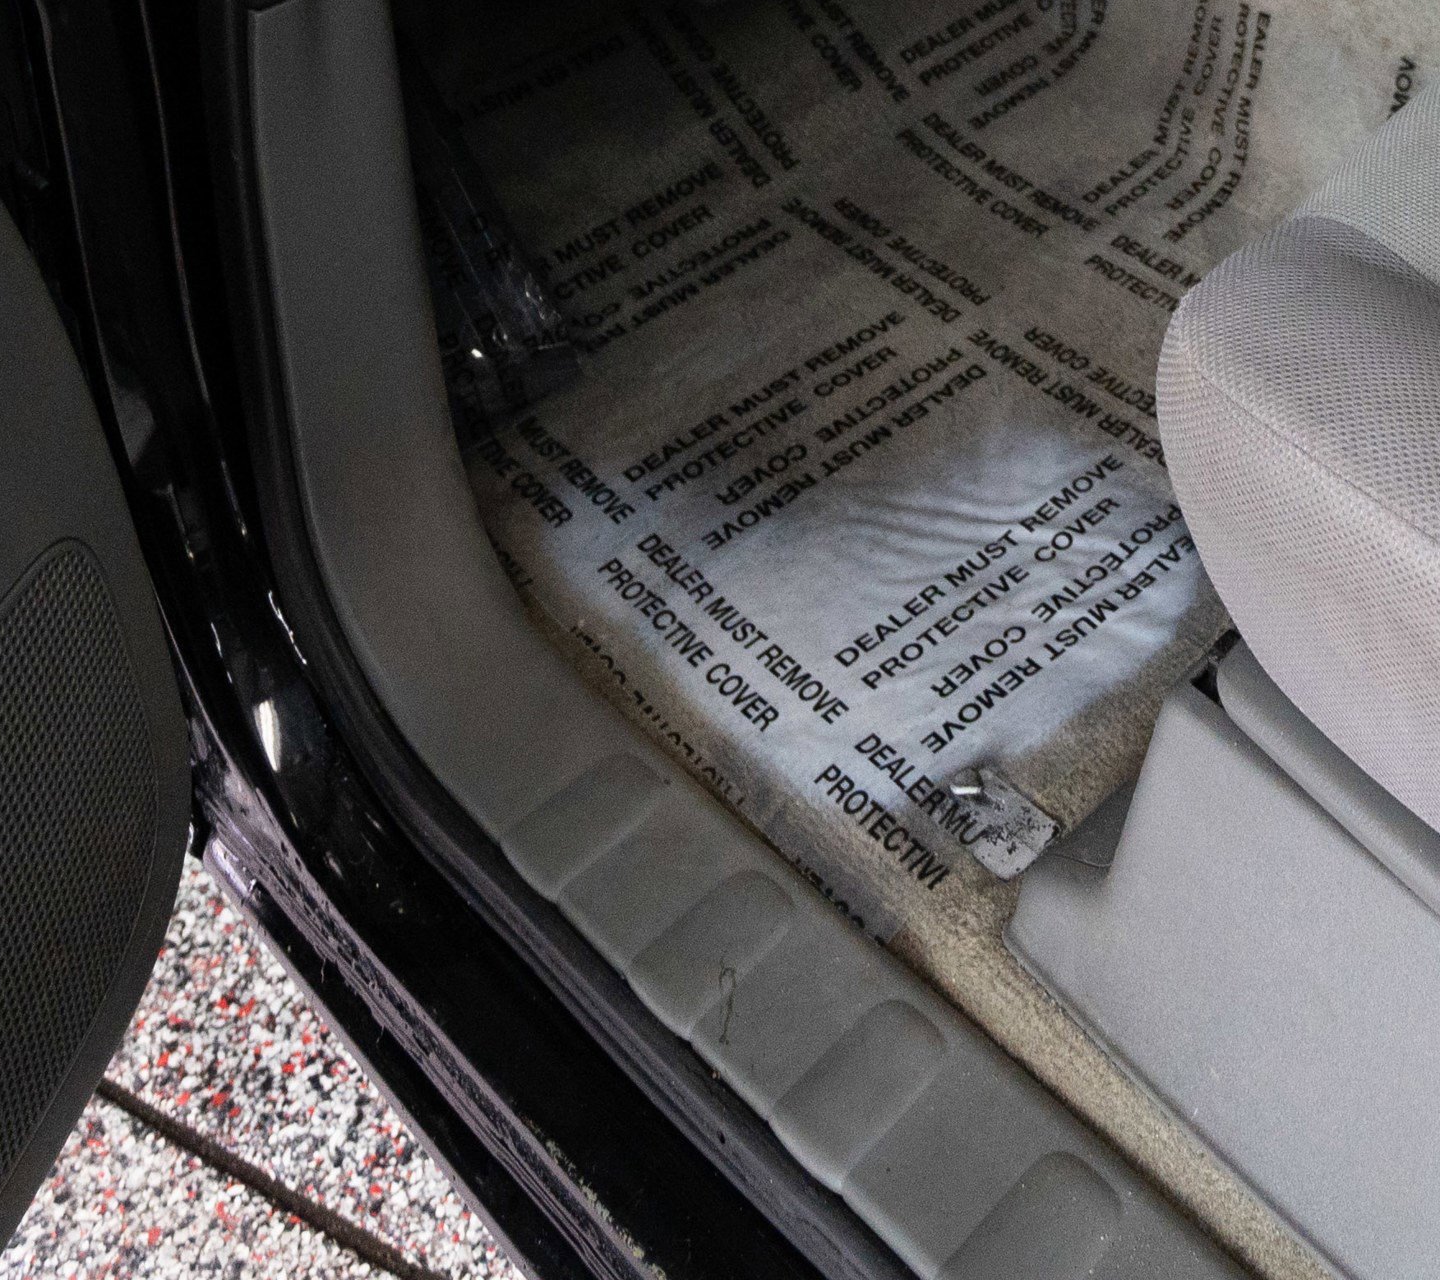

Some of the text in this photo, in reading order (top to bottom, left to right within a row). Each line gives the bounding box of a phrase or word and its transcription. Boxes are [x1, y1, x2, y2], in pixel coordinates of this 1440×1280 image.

[811, 33, 862, 92] COVER
[850, 30, 910, 104] REMOVE
[900, 17, 974, 65] DEALER
[919, 12, 1035, 87] PROTECTIVE
[974, 55, 1039, 98] COVER
[1052, 31, 1098, 81] MUST
[1210, 2, 1251, 135] ROTECTIVE
[1246, 10, 1271, 91] EALER
[709, 117, 771, 189] DEALER
[711, 62, 800, 172] PROTECTIVE
[969, 77, 1051, 131] REMOVE
[1082, 149, 1158, 205] DEALER
[1154, 83, 1186, 147] MUST
[1105, 16, 1223, 216] PROTECTIVE COVER
[1233, 96, 1251, 165] MUST
[554, 160, 724, 264] MUST REMOVE
[896, 128, 1049, 238] PROTECTIVE COVER
[923, 112, 1101, 232] DEALER MUST REMOVE
[1163, 171, 1241, 243] REMOVE
[1166, 146, 1222, 210] COVER
[553, 204, 714, 300] CTIVE COVER
[627, 216, 772, 300] PROTECTIVE
[630, 229, 792, 330] DEALER MUST
[781, 197, 963, 323] DEALER MUST REMOVE
[833, 196, 991, 307] PROTECTIVE COVER
[1111, 234, 1183, 283] DEALER
[623, 310, 906, 484] DEALER MUST REMOVE
[645, 345, 899, 502] PROTECTIVE COVER
[965, 328, 1102, 420] MUST REMOVE
[1024, 327, 1157, 420] TECTIVE COVER
[516, 416, 637, 525] MUST REMOVE
[700, 363, 988, 550] DEALER MUST REMOVE
[716, 347, 964, 507] PROTECTIVE COVER
[511, 469, 574, 530] COVER
[834, 454, 1125, 668] DEALER MUST REMOVE
[861, 497, 1121, 691] PROTECTIVE COVER
[930, 502, 1185, 699] PROTECTIVE COVER
[597, 558, 714, 670] PROTECTIVE
[705, 662, 779, 733] COVER
[637, 532, 715, 605] DEALER
[704, 596, 770, 651] MUST
[756, 643, 849, 727] REMOVE
[920, 533, 1195, 754] EALER MUST REMOVE
[854, 733, 985, 848] DEALER MU
